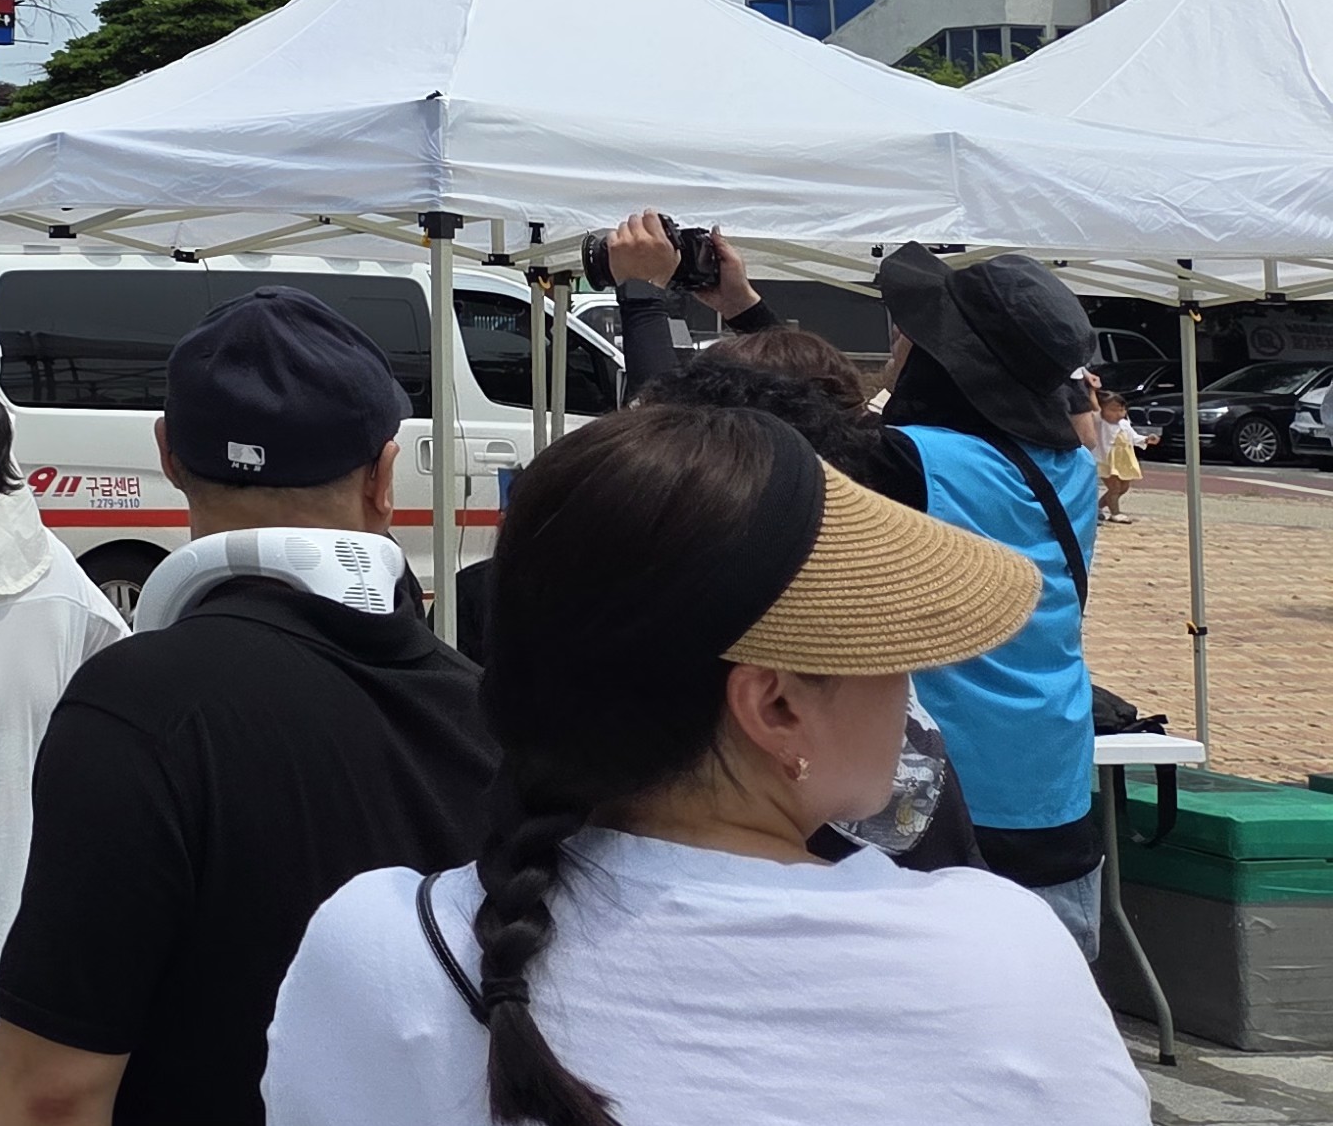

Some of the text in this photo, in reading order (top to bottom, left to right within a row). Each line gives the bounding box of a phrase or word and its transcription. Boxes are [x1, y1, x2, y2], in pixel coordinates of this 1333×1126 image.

[27, 466, 141, 497] 911 구급센터
[97, 498, 140, 508] 279-9110
